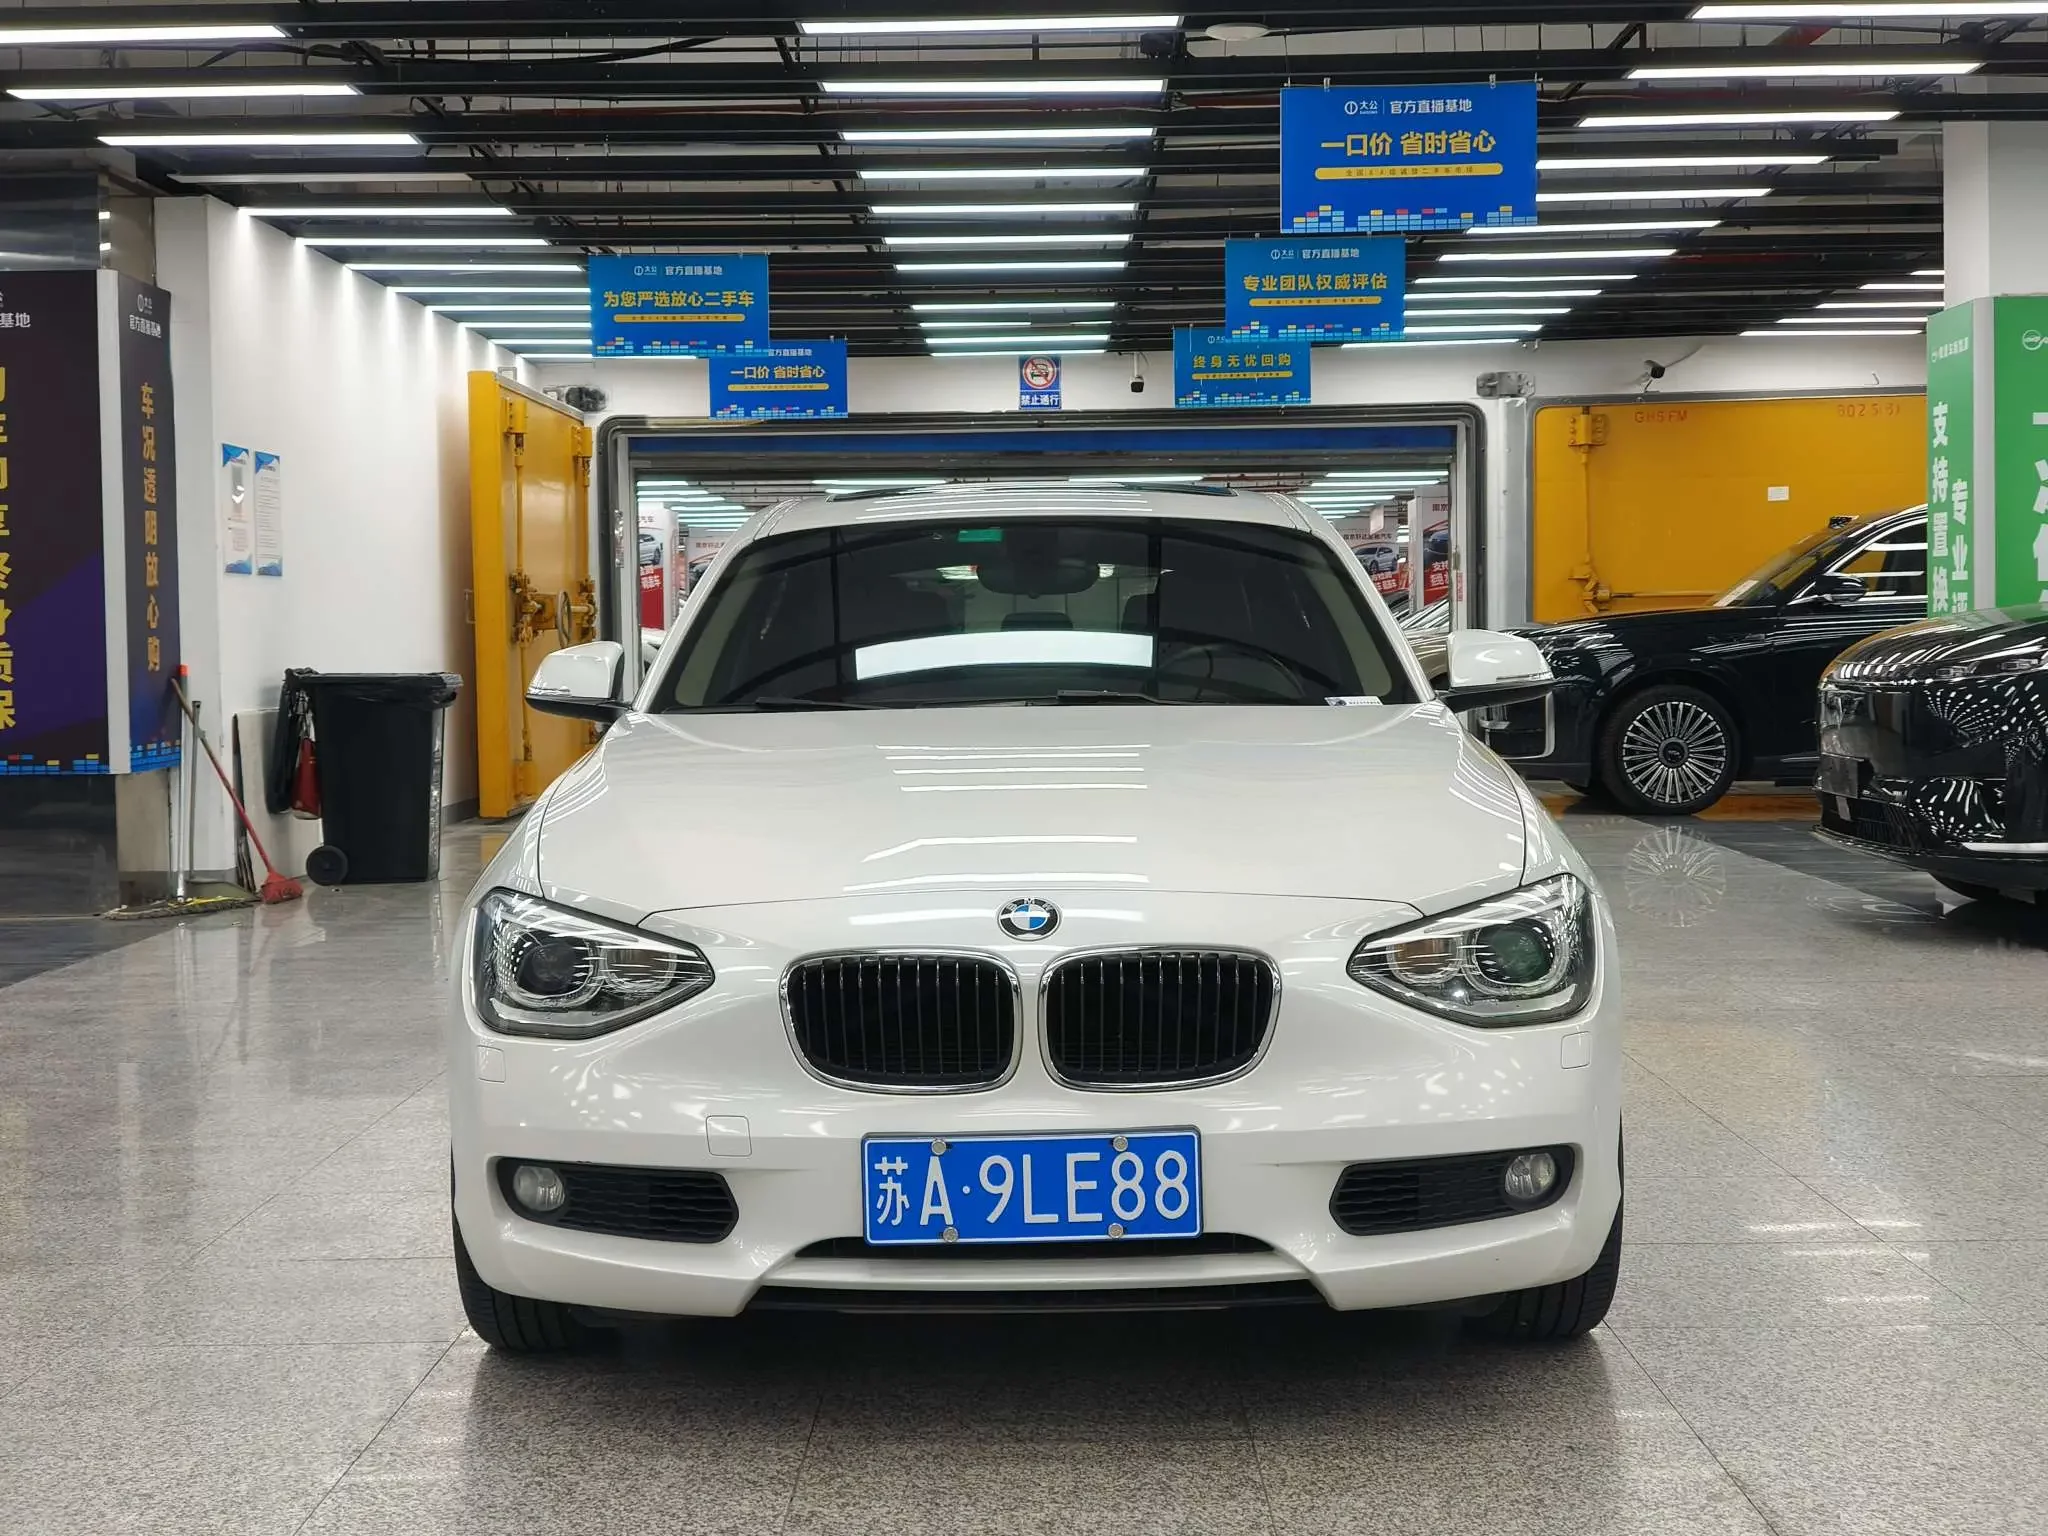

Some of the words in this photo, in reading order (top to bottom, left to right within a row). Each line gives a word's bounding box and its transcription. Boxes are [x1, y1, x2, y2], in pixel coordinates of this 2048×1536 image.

[1360, 100, 1378, 110] 大公
[1390, 98, 1473, 115] 官方直播基地
[1321, 132, 1393, 156] 一口价
[1400, 129, 1496, 155] 省时省心
[1302, 248, 1360, 260] 官方直播基地
[665, 265, 723, 276] 官方直播基地
[1243, 272, 1388, 292] 专业团队权威评估
[603, 290, 754, 308] 为您严选放心二手车
[1193, 353, 1291, 369] 终身无忧回购
[730, 366, 769, 379] 一口价
[774, 365, 826, 379] 省时省心
[1932, 401, 1949, 613] 支持置换
[139, 382, 161, 672] 车况透明放心购
[874, 1150, 1190, 1226] 苏A·9LE88
